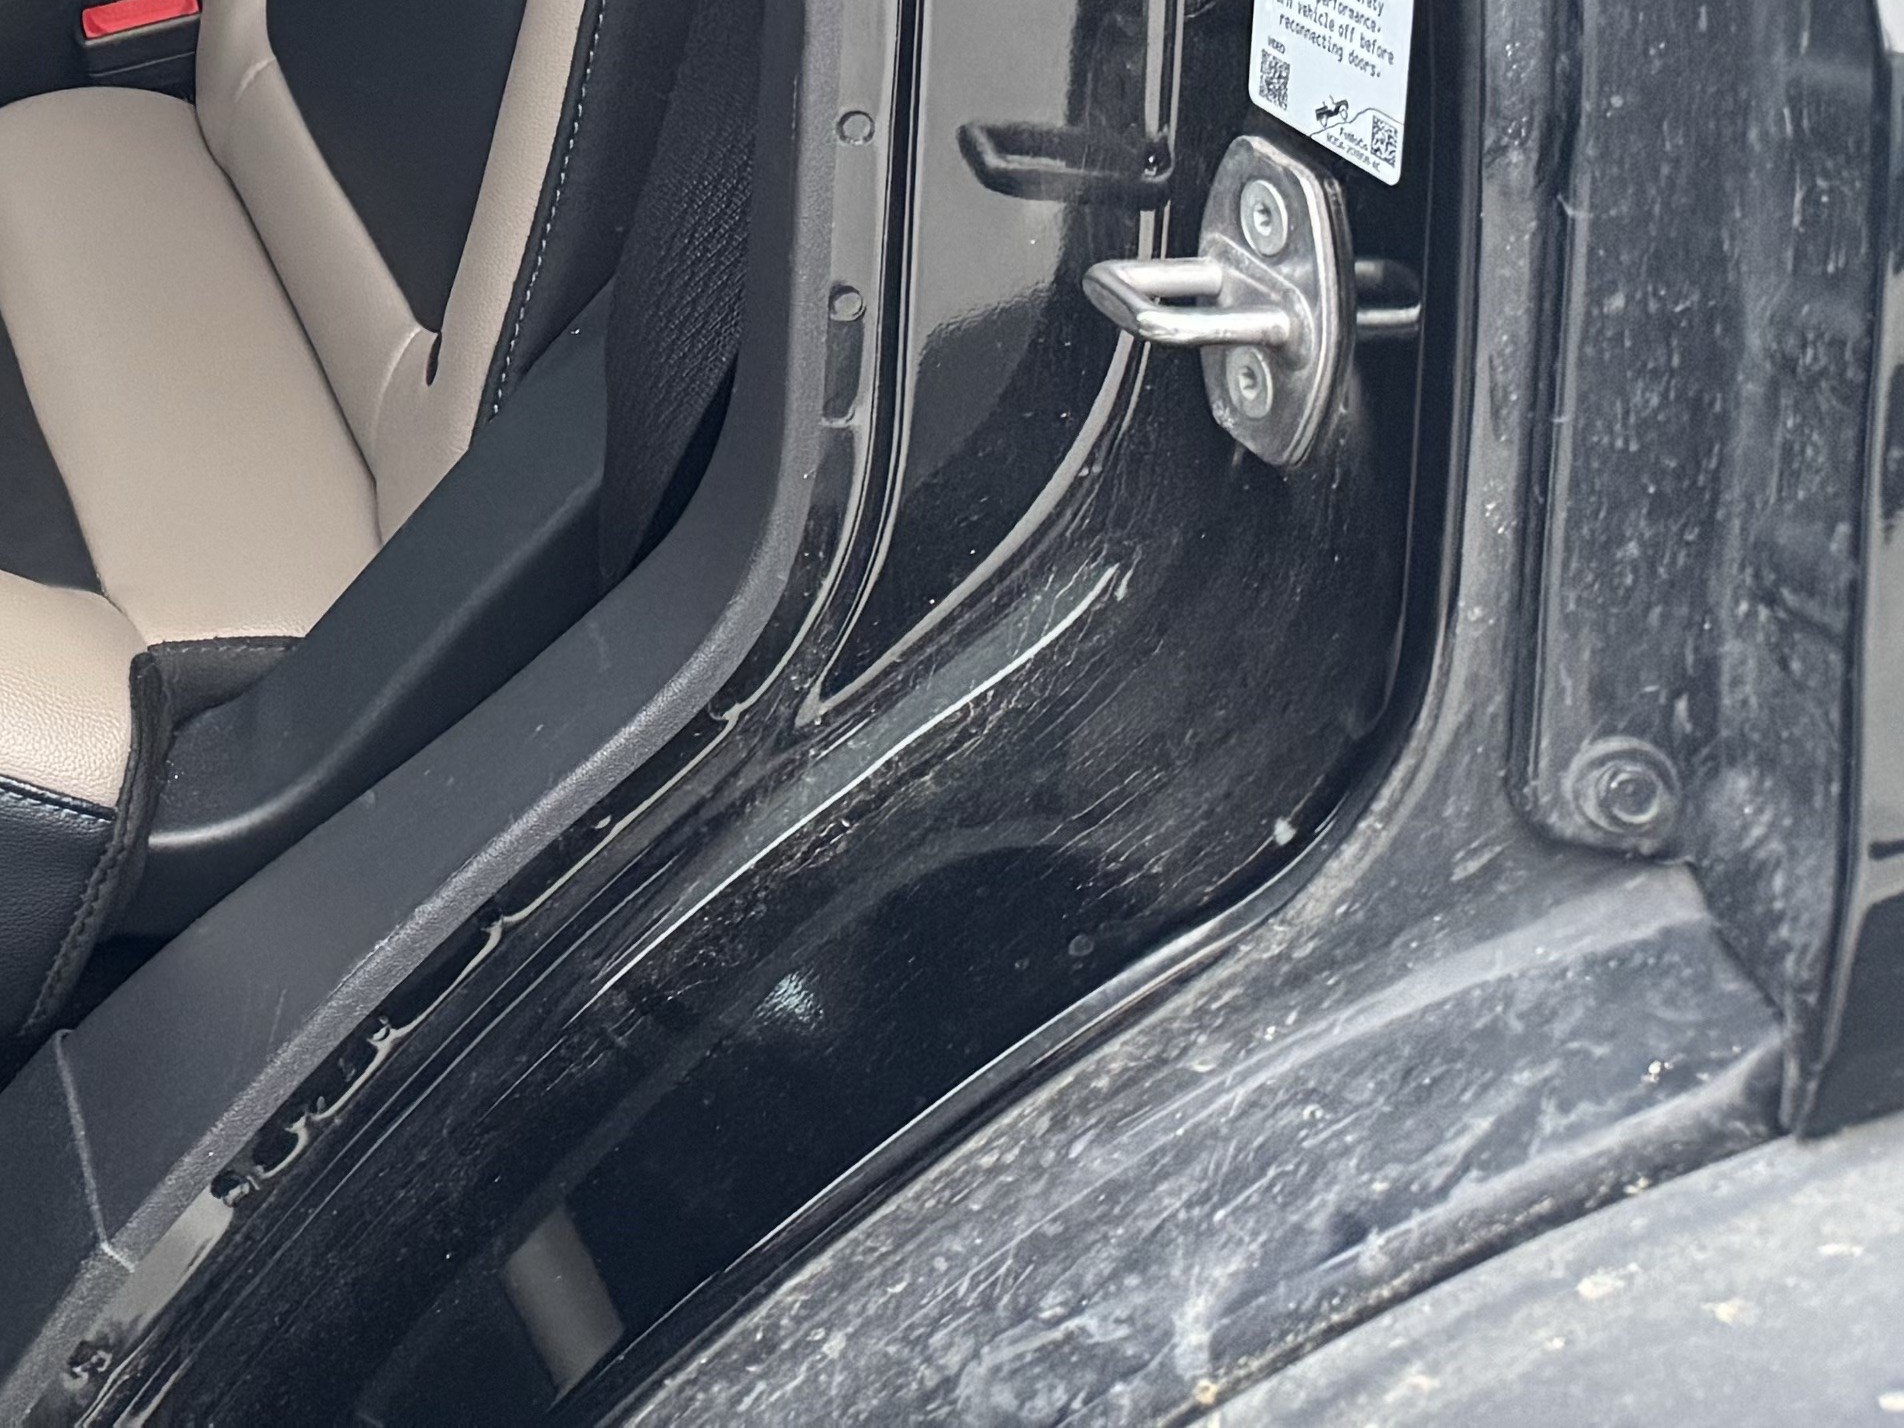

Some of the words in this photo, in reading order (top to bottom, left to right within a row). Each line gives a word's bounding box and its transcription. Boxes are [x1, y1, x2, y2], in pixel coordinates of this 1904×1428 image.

[1280, 14, 1343, 62] reconnecting
[1349, 50, 1381, 78] doors.
[1298, 2, 1335, 32] vehicle
[1338, 24, 1355, 42] off
[1360, 33, 1395, 65] before
